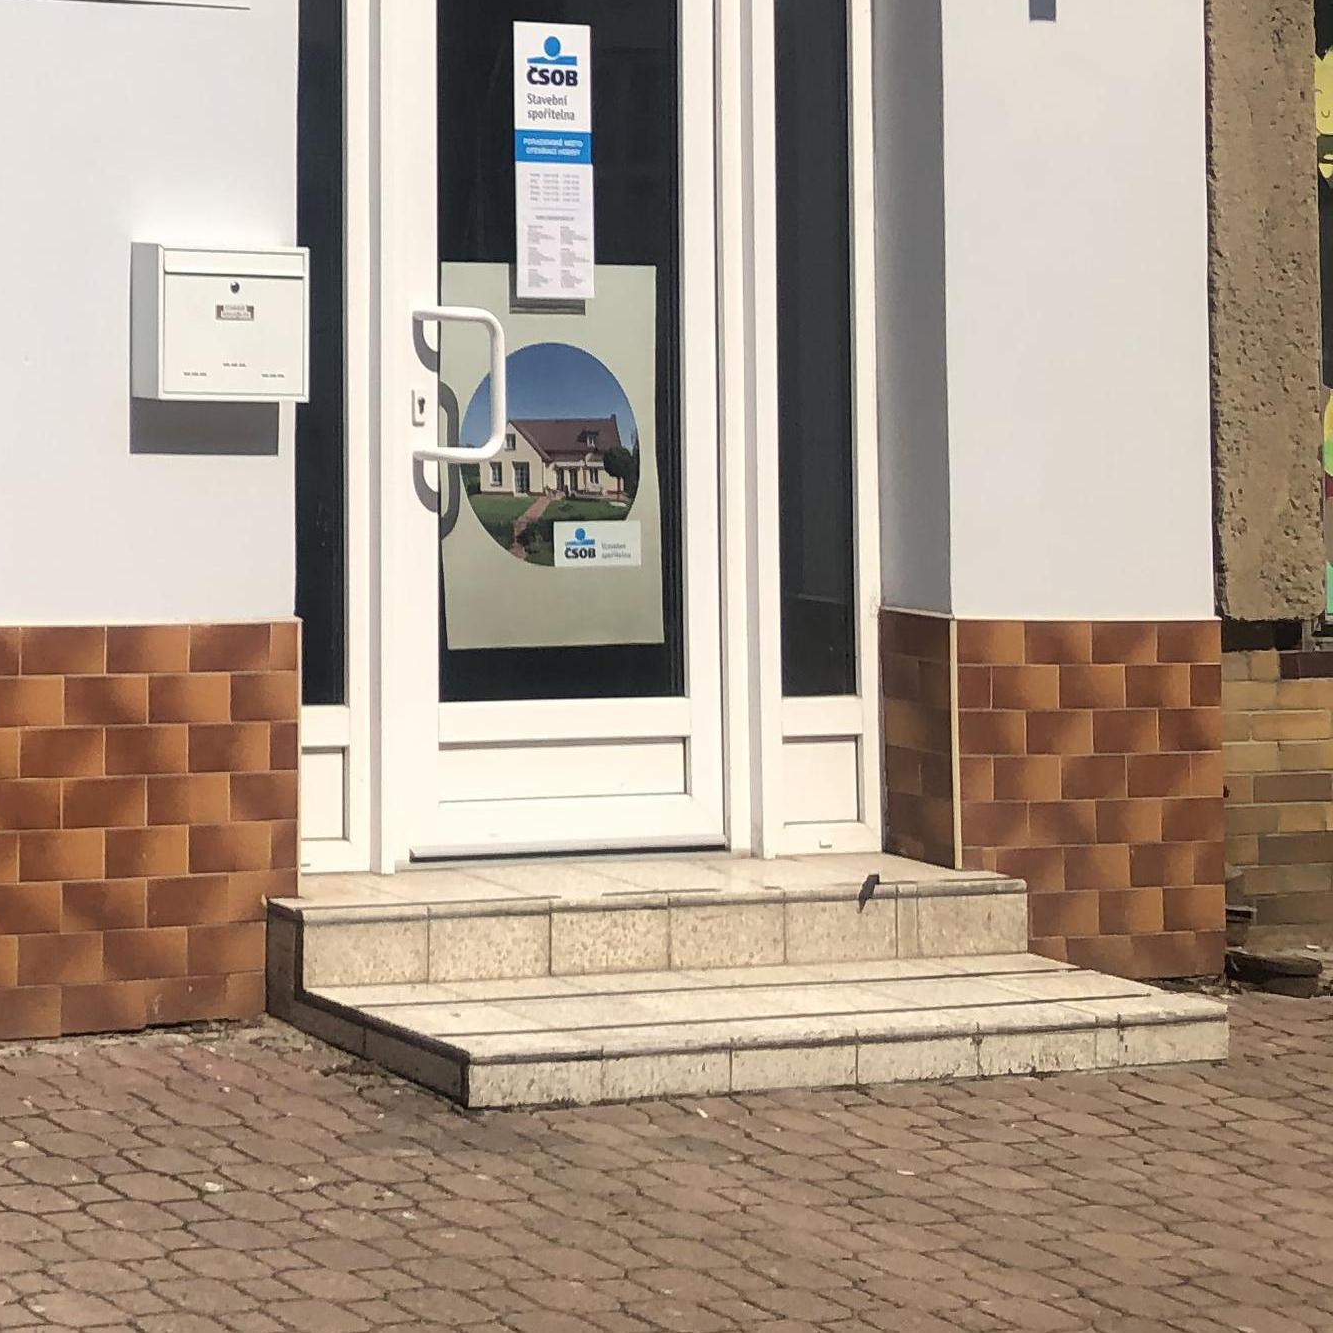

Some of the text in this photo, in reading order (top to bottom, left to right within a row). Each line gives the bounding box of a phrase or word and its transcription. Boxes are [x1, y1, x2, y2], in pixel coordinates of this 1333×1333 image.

[526, 66, 579, 86] ČSOB
[527, 93, 568, 106] Stavební
[527, 108, 575, 122] spořitelna
[564, 547, 596, 559] ČSOB
